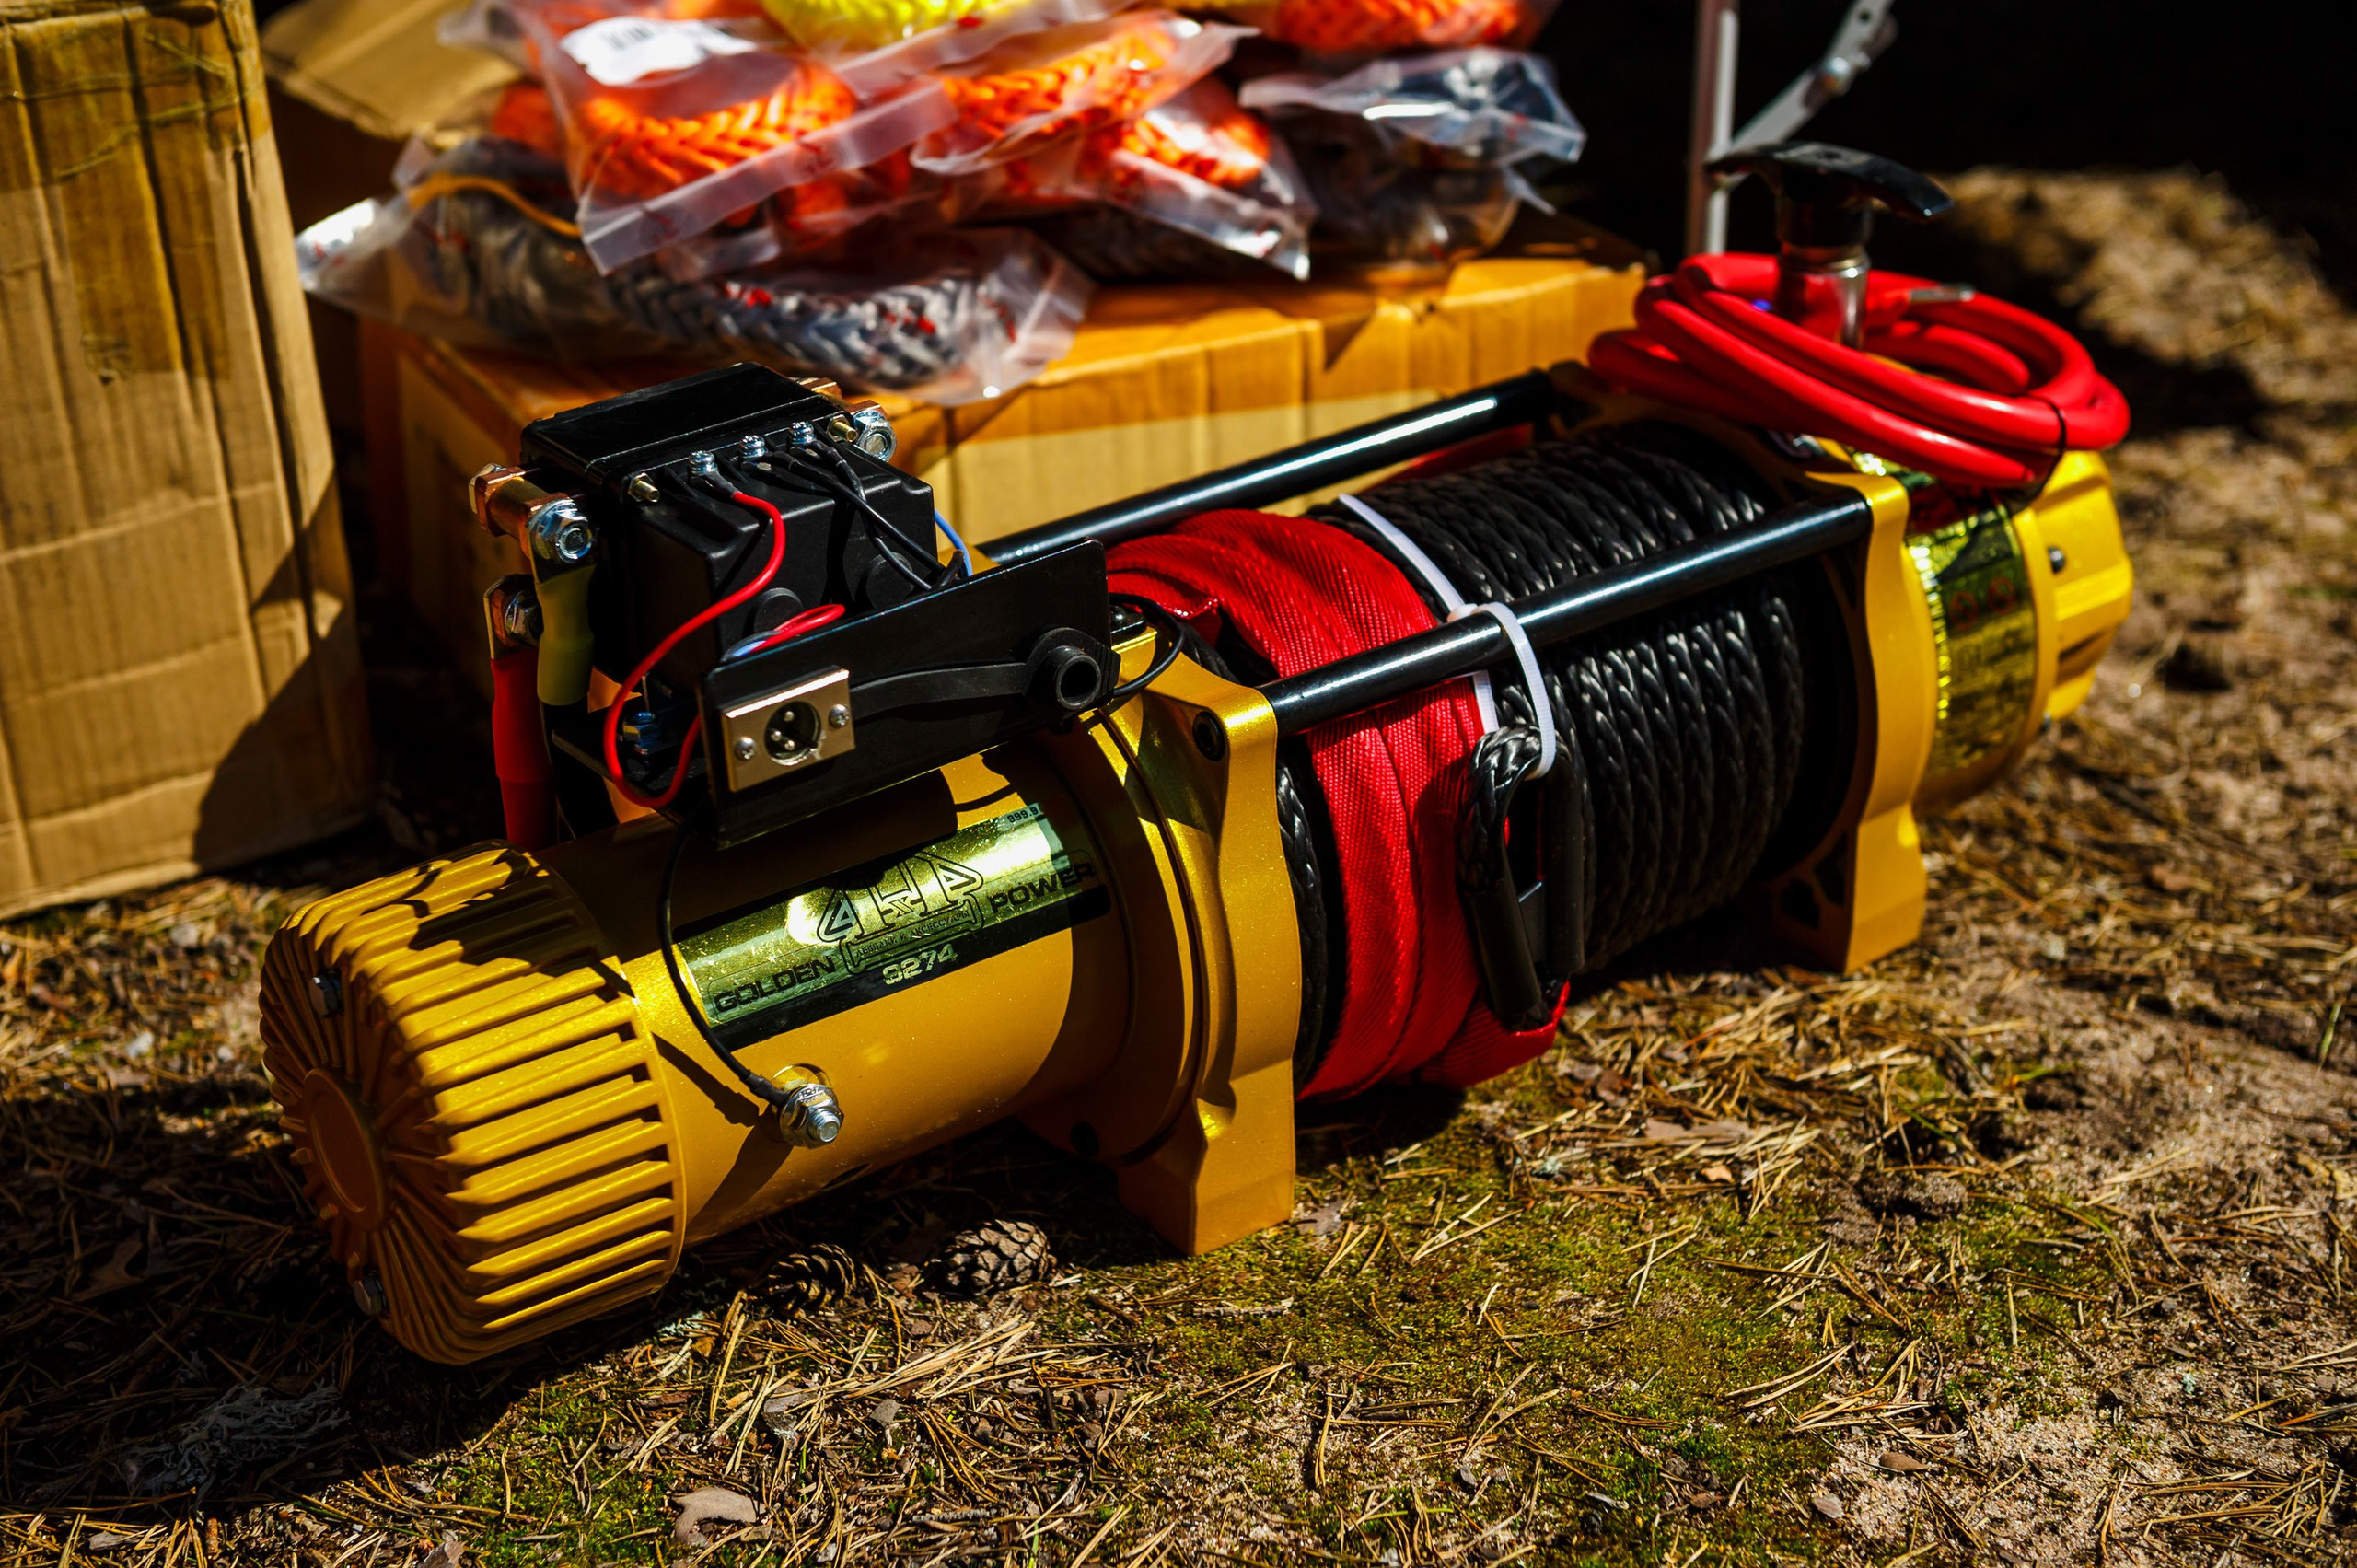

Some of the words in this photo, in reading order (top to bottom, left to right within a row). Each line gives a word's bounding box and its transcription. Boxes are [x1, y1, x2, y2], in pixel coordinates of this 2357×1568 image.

[1006, 806, 1039, 823] 999.9
[714, 954, 837, 1013] GOLDEN
[986, 863, 1096, 913] POWER
[910, 910, 971, 938] АКСЕССУАРЫ
[881, 943, 958, 986] 9274
